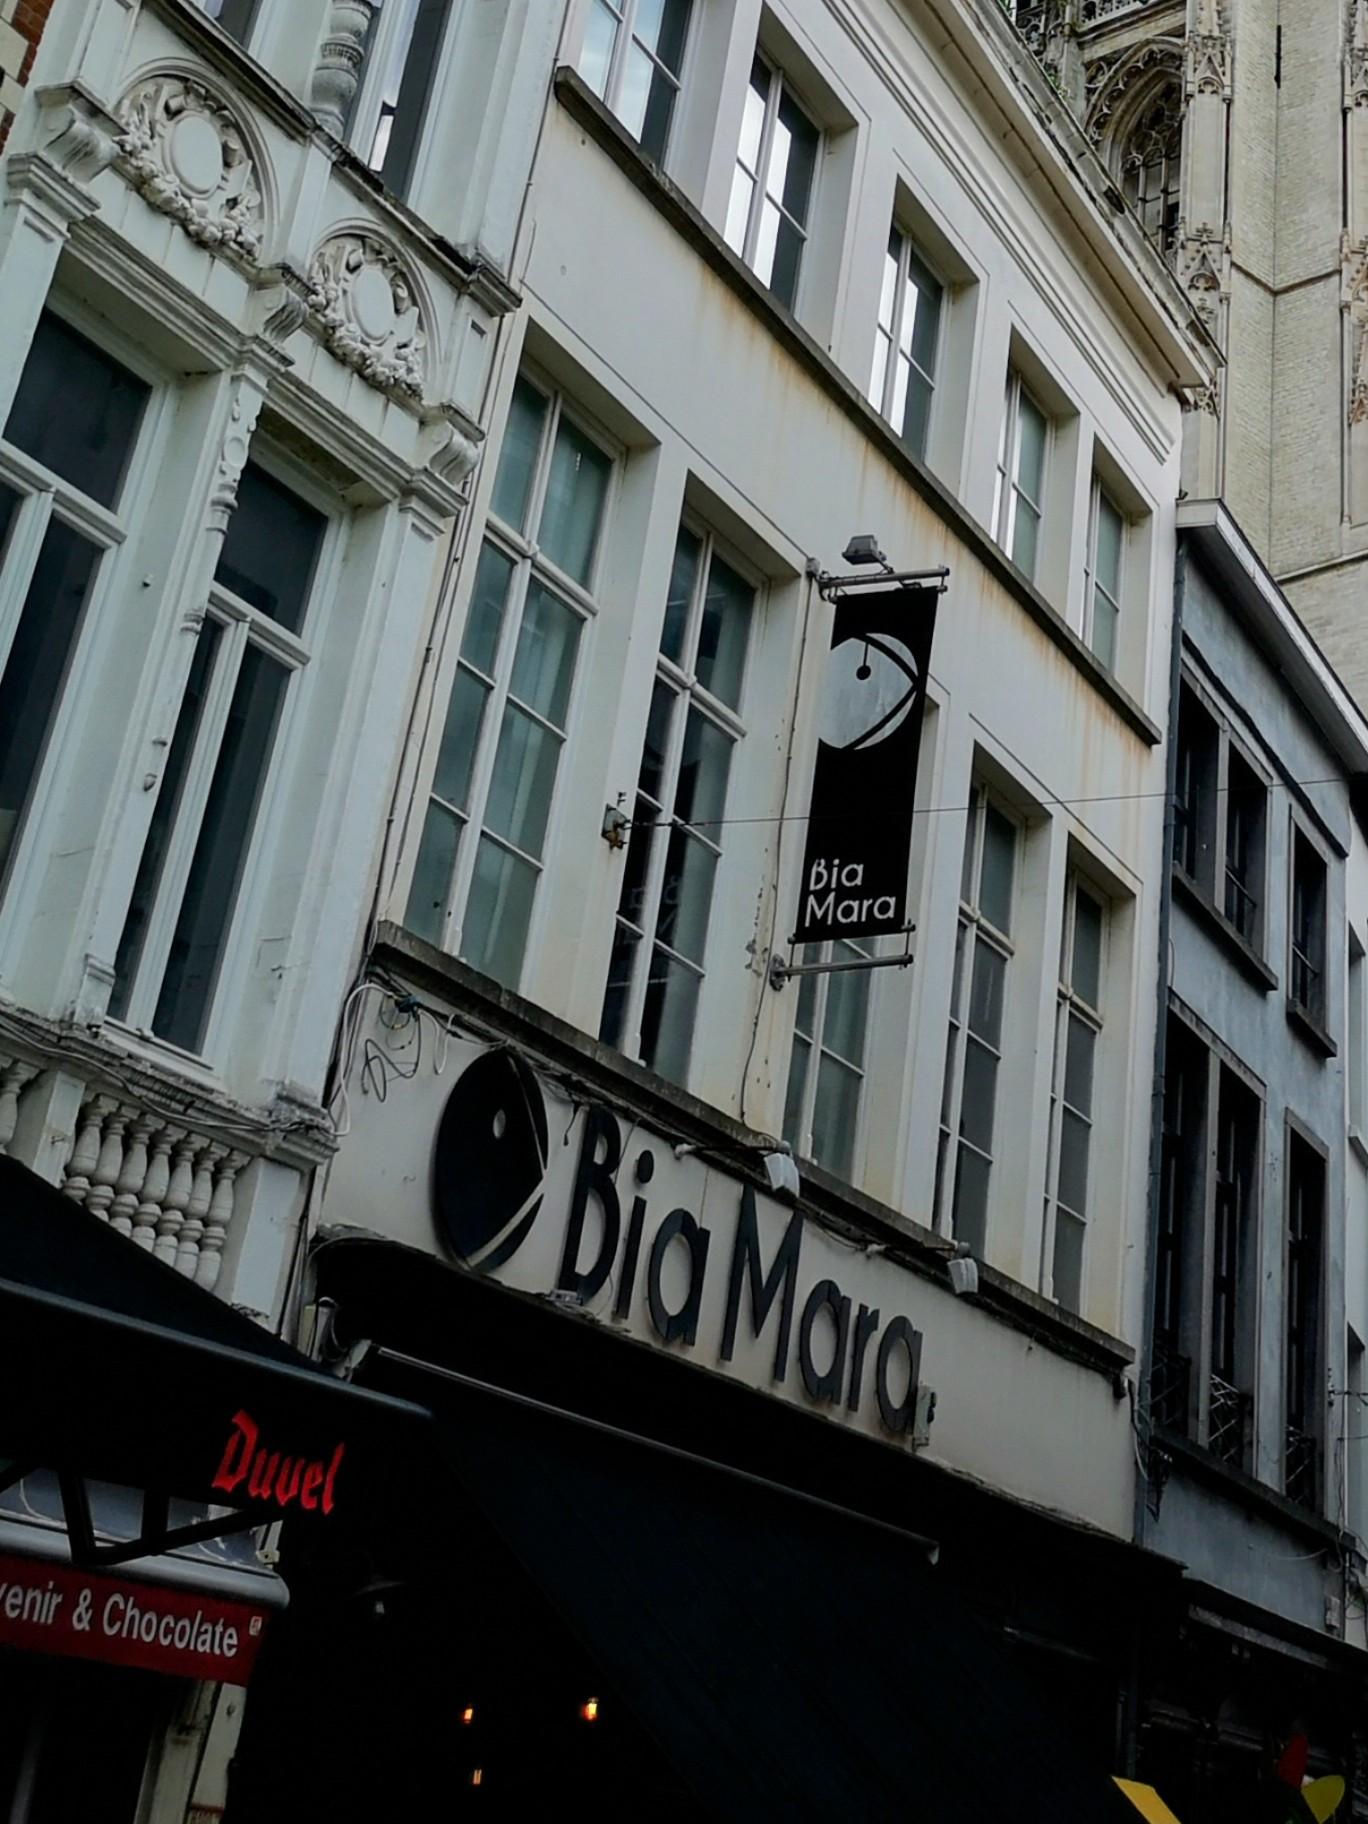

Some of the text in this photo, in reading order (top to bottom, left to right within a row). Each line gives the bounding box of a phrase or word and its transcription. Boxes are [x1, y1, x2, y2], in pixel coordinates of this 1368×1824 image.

[805, 891, 896, 927] Mara
[809, 858, 864, 891] Bia
[557, 1104, 922, 1434] Bia Mara
[211, 1408, 345, 1515] Duvel
[72, 1588, 93, 1631] &
[103, 1593, 238, 1658] Chocolate
